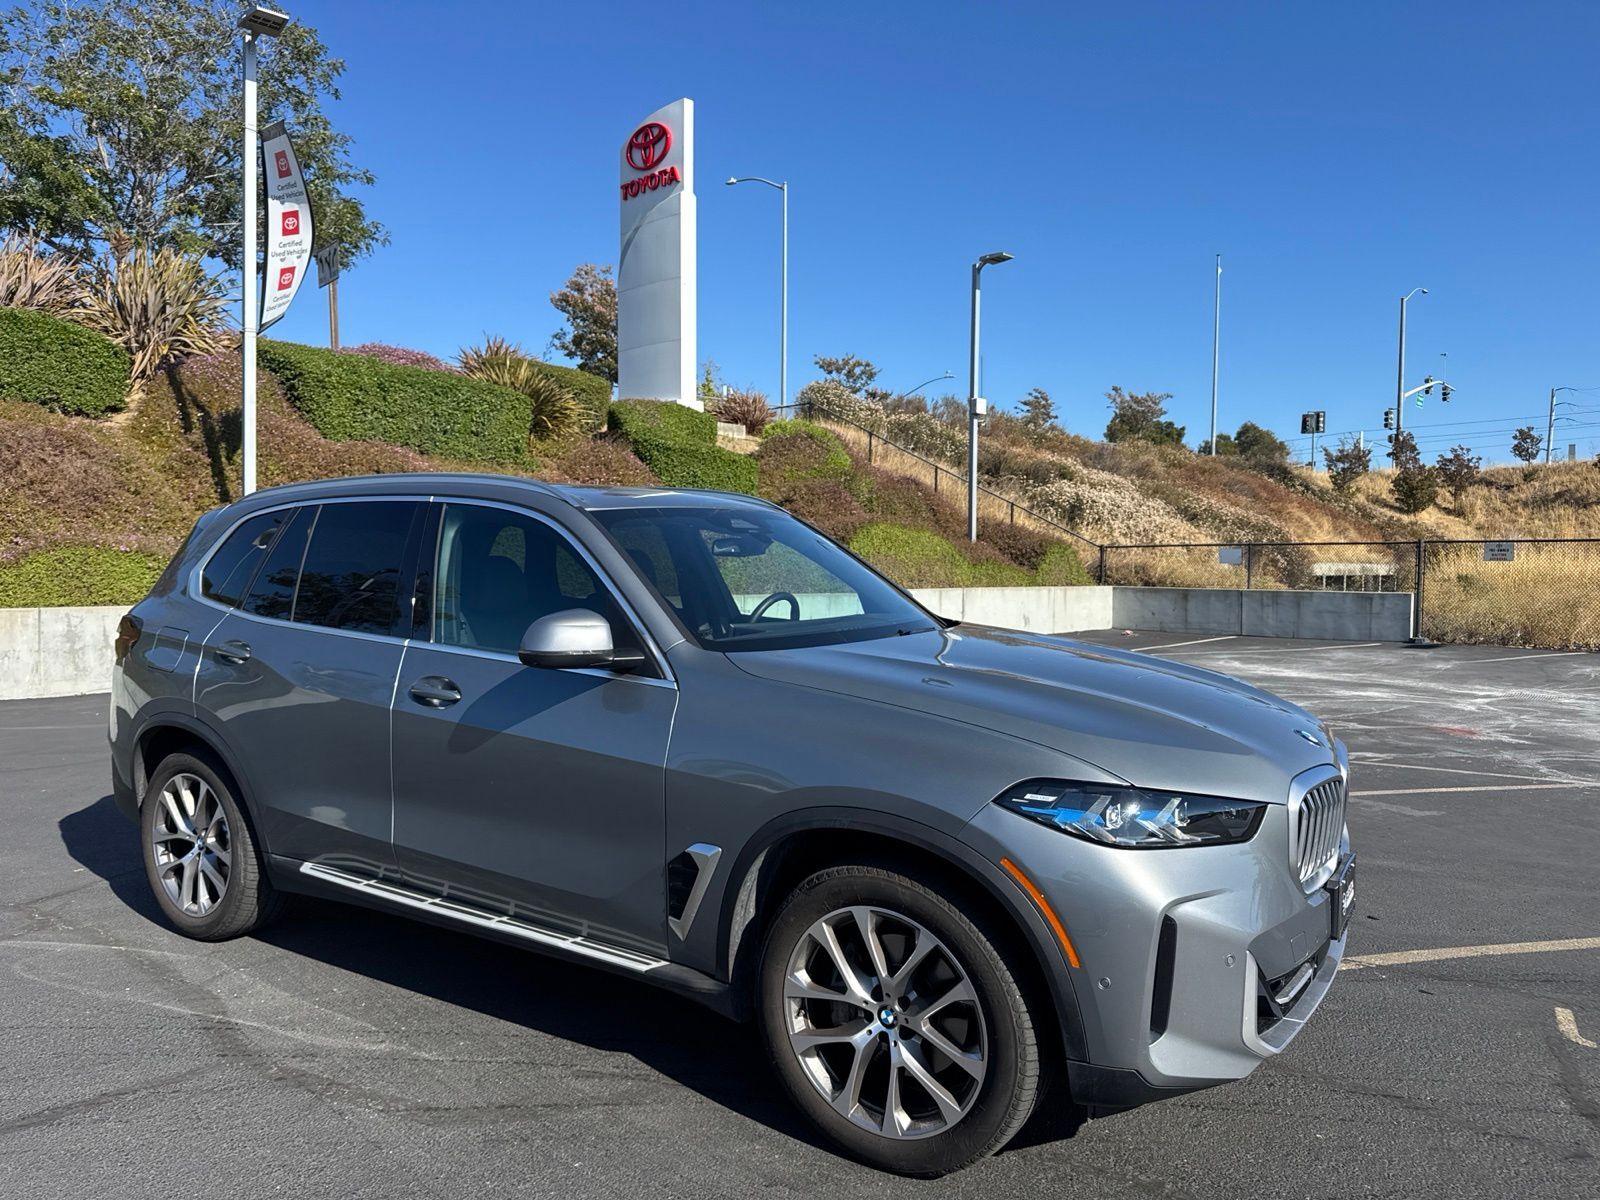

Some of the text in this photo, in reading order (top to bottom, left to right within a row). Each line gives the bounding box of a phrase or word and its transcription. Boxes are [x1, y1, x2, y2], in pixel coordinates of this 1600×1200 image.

[277, 181, 297, 191] Certified
[620, 165, 681, 200] TOYOTA
[278, 240, 303, 248] Certified
[286, 248, 308, 256] Vehicles
